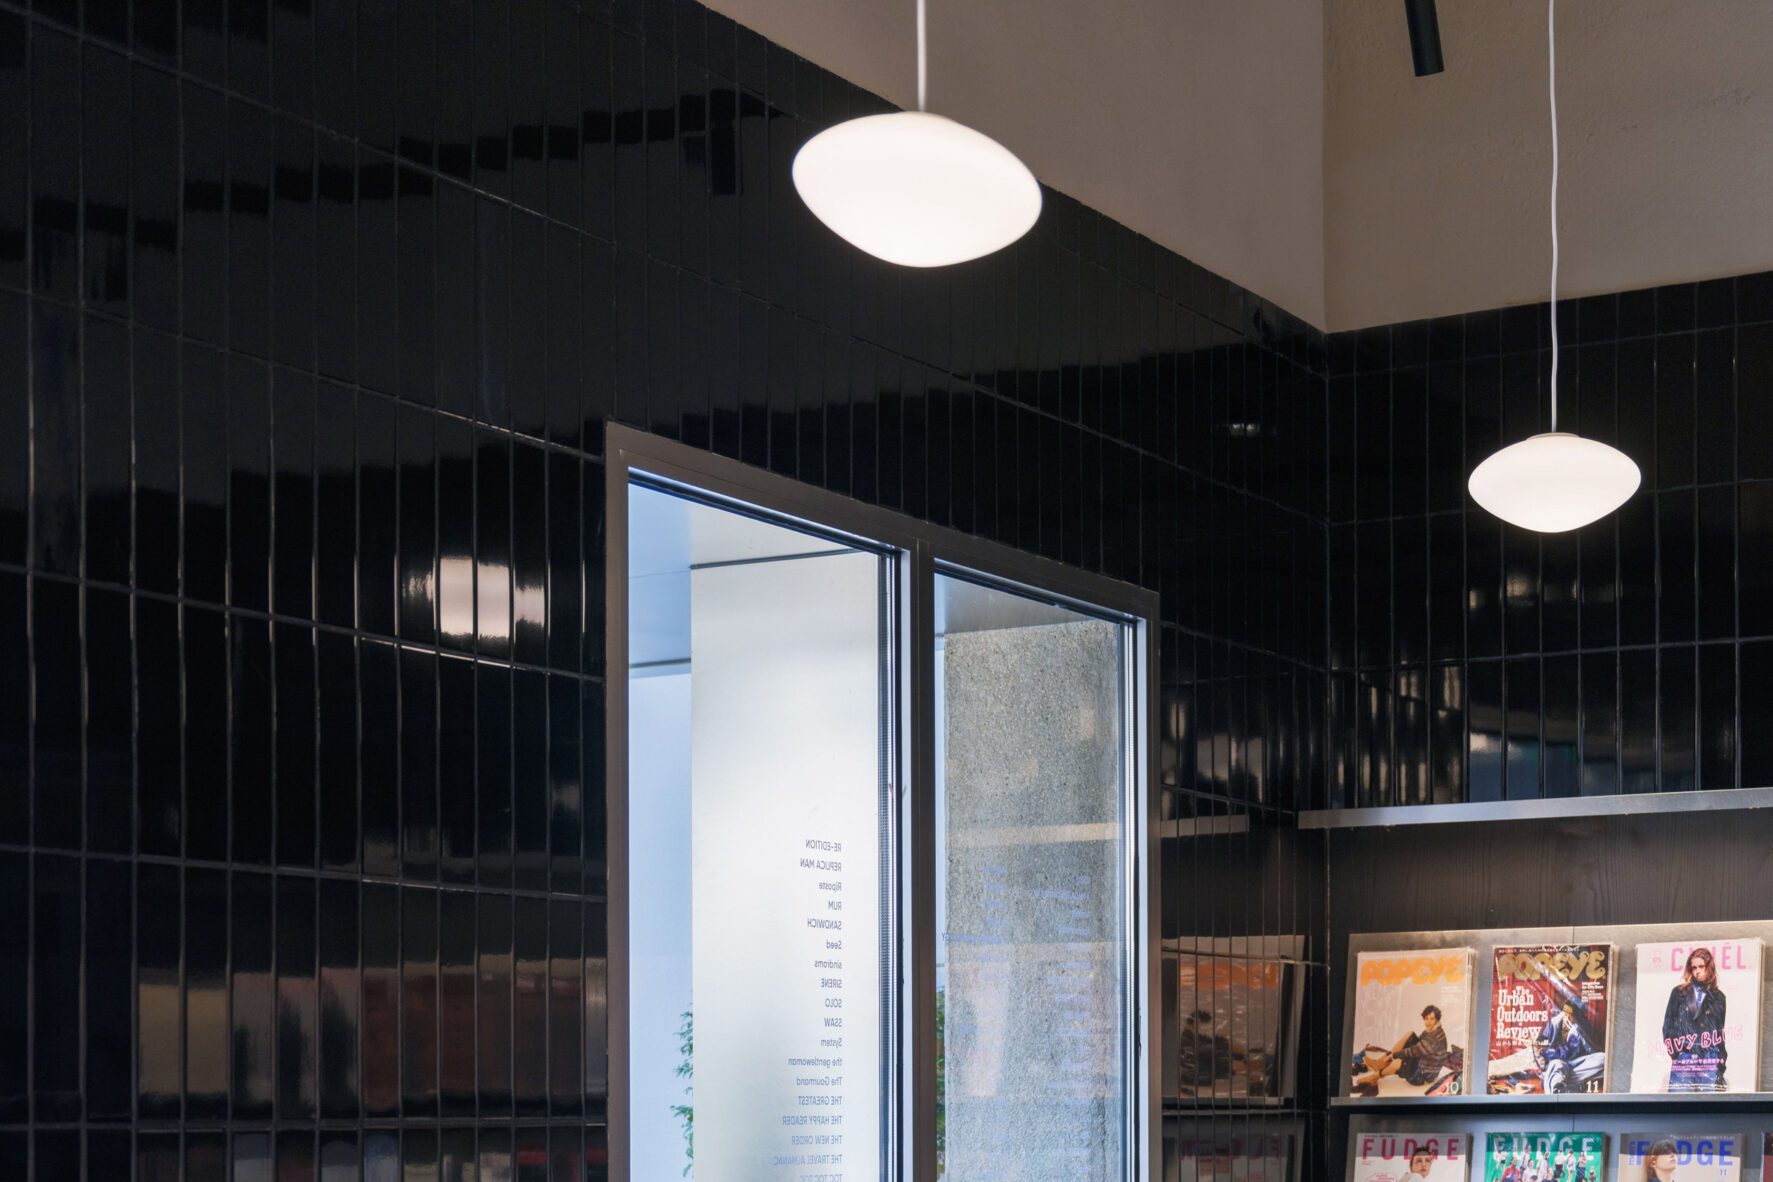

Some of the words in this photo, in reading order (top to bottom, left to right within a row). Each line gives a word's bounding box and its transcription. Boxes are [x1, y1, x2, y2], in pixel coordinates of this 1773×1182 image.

[1498, 951, 1606, 980] POPEYE
[1671, 943, 1746, 972] CÉL
[1360, 956, 1465, 986] POPEYE
[1499, 990, 1534, 1006] Urban
[1516, 986, 1530, 996] The
[1497, 1007, 1548, 1022] Outdoors
[1496, 1024, 1542, 1039] Review
[1446, 1082, 1459, 1095] 10
[1587, 1081, 1599, 1093] 11
[1362, 1138, 1459, 1160] FUDGE
[1494, 1137, 1594, 1160] FUDGE
[1636, 1141, 1734, 1166] FDGE
